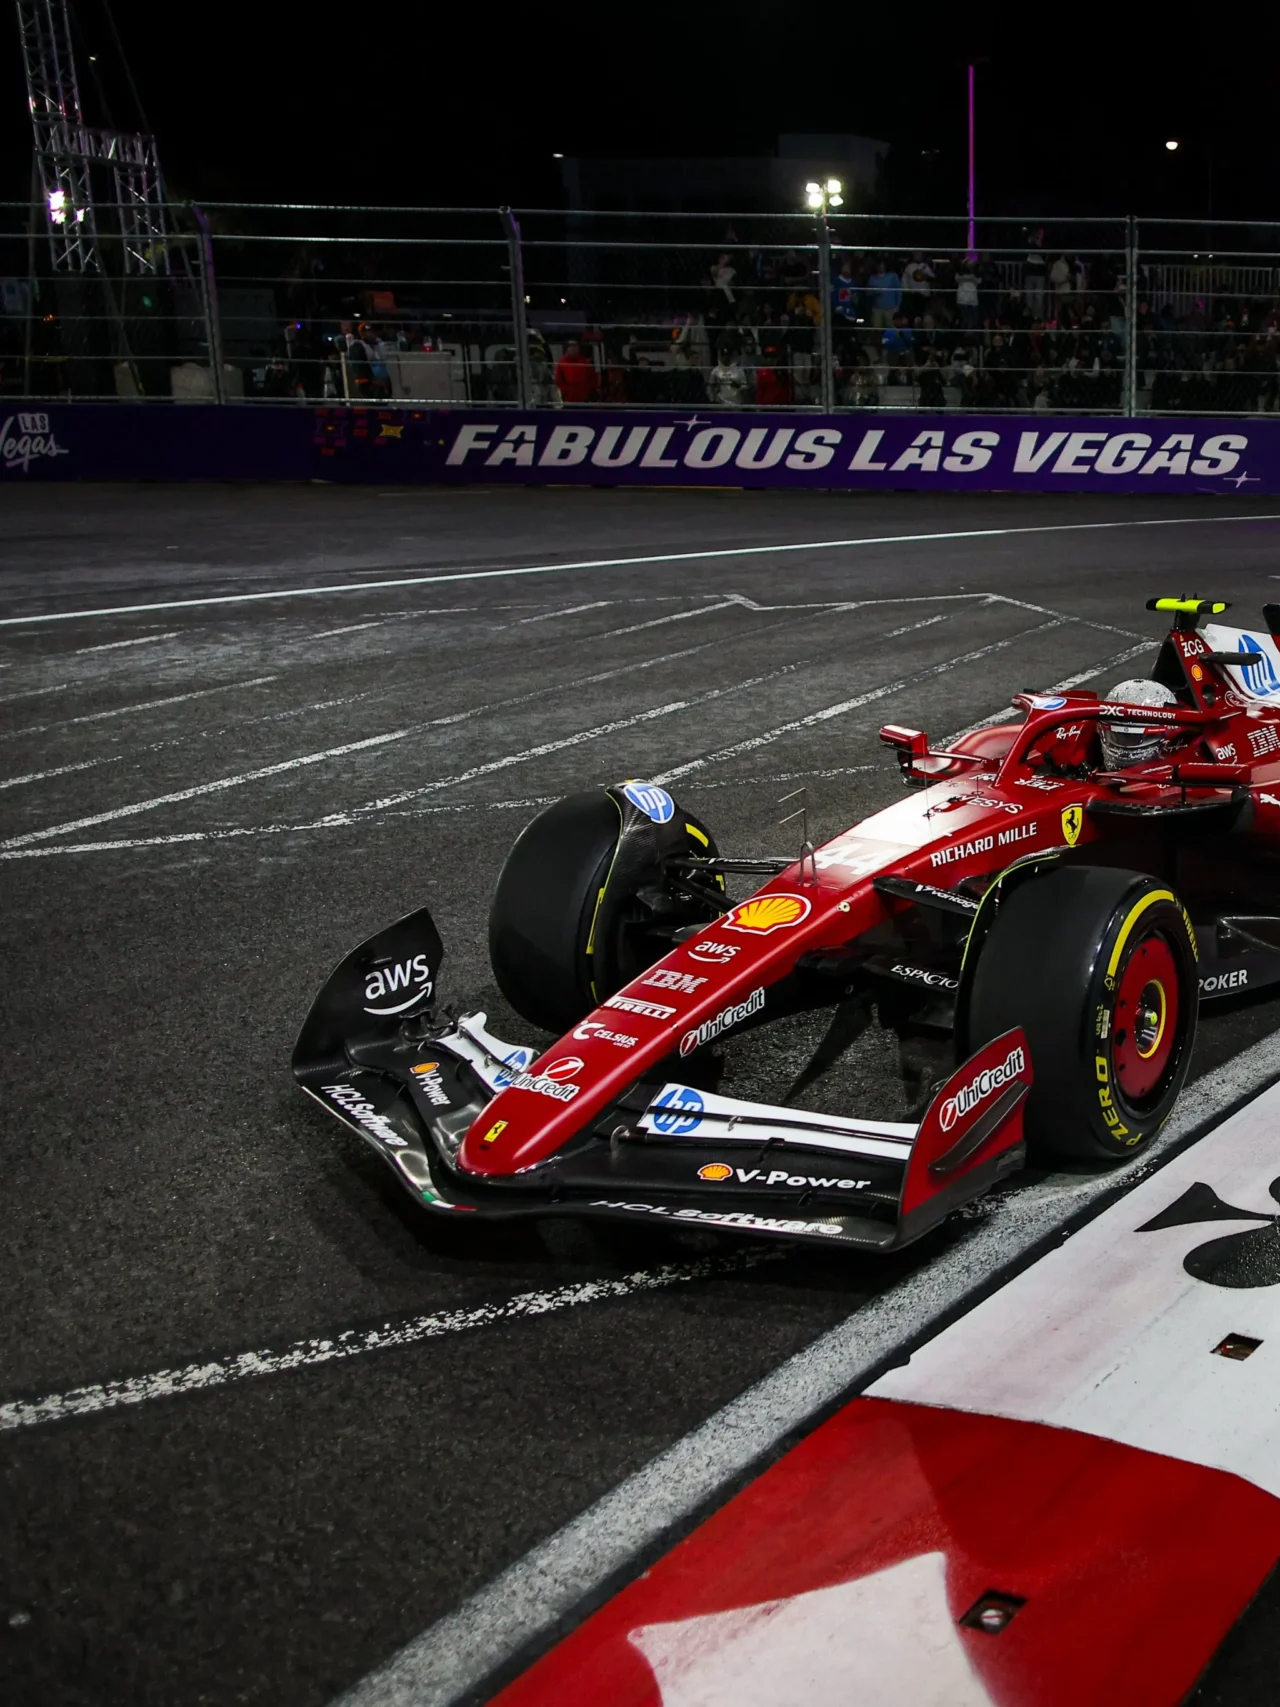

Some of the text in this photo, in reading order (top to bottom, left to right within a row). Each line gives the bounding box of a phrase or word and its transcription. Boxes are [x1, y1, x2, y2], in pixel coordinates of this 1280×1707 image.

[20, 414, 48, 432] LAS
[446, 425, 1248, 475] FABULOUS LAS VEGAS
[1181, 639, 1204, 657] ZCG
[1099, 705, 1176, 719] DXC TECHNOLOGY
[1216, 743, 1237, 760] aws
[628, 784, 672, 824] hp
[931, 822, 1037, 867] RICHARD MILLE
[694, 941, 741, 957] aws
[365, 954, 429, 999] aws
[641, 969, 708, 994] IBM
[601, 996, 677, 1020] PIRELLI
[699, 988, 764, 1045] UniCredit
[594, 1029, 639, 1046] CELSIUS
[415, 1069, 451, 1106] V-Power
[512, 1073, 580, 1101] UniCredit
[956, 1047, 1024, 1115] UniCredit
[655, 1089, 703, 1134] hp
[1095, 1056, 1129, 1141] ZERO
[1126, 1132, 1142, 1146] P
[735, 1168, 871, 1190] V-Power
